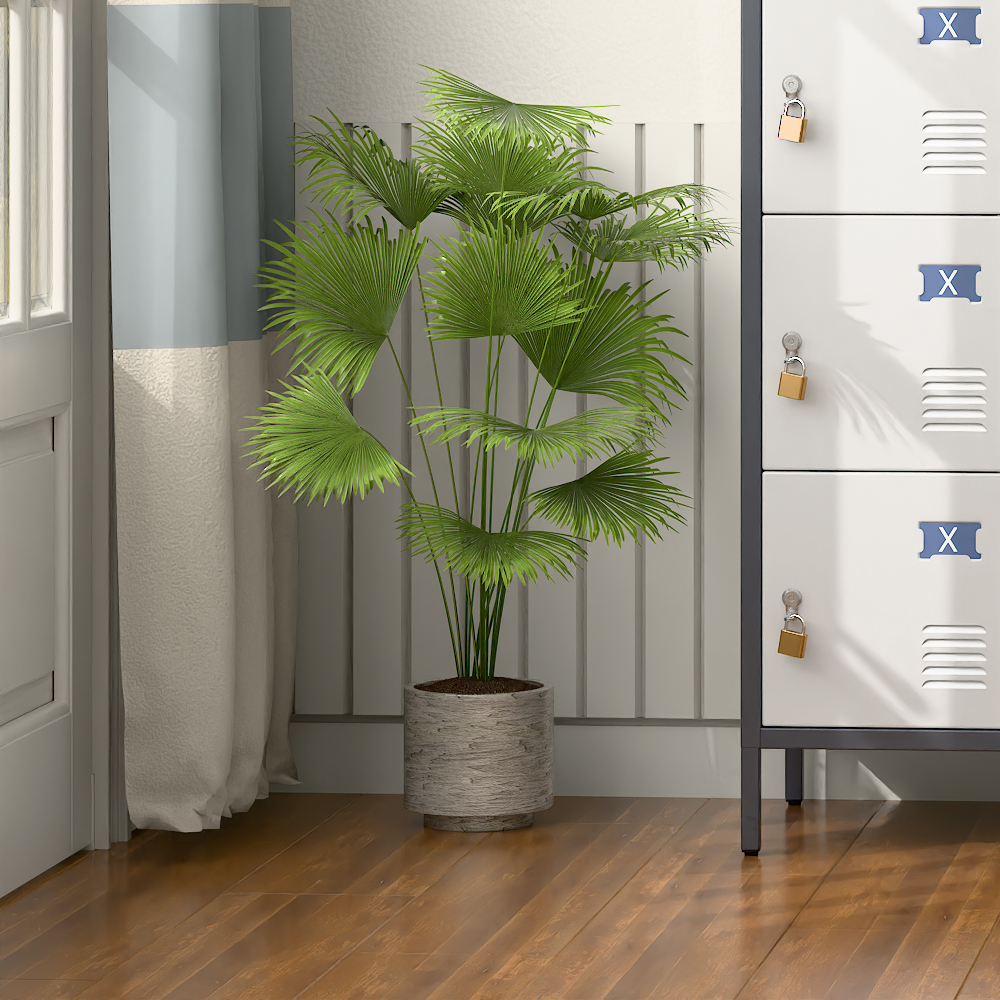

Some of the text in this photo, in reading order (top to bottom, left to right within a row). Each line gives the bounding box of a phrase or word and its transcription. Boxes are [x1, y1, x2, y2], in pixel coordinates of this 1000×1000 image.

[938, 12, 958, 38] X
[938, 269, 958, 296] X
[938, 526, 958, 553] X
